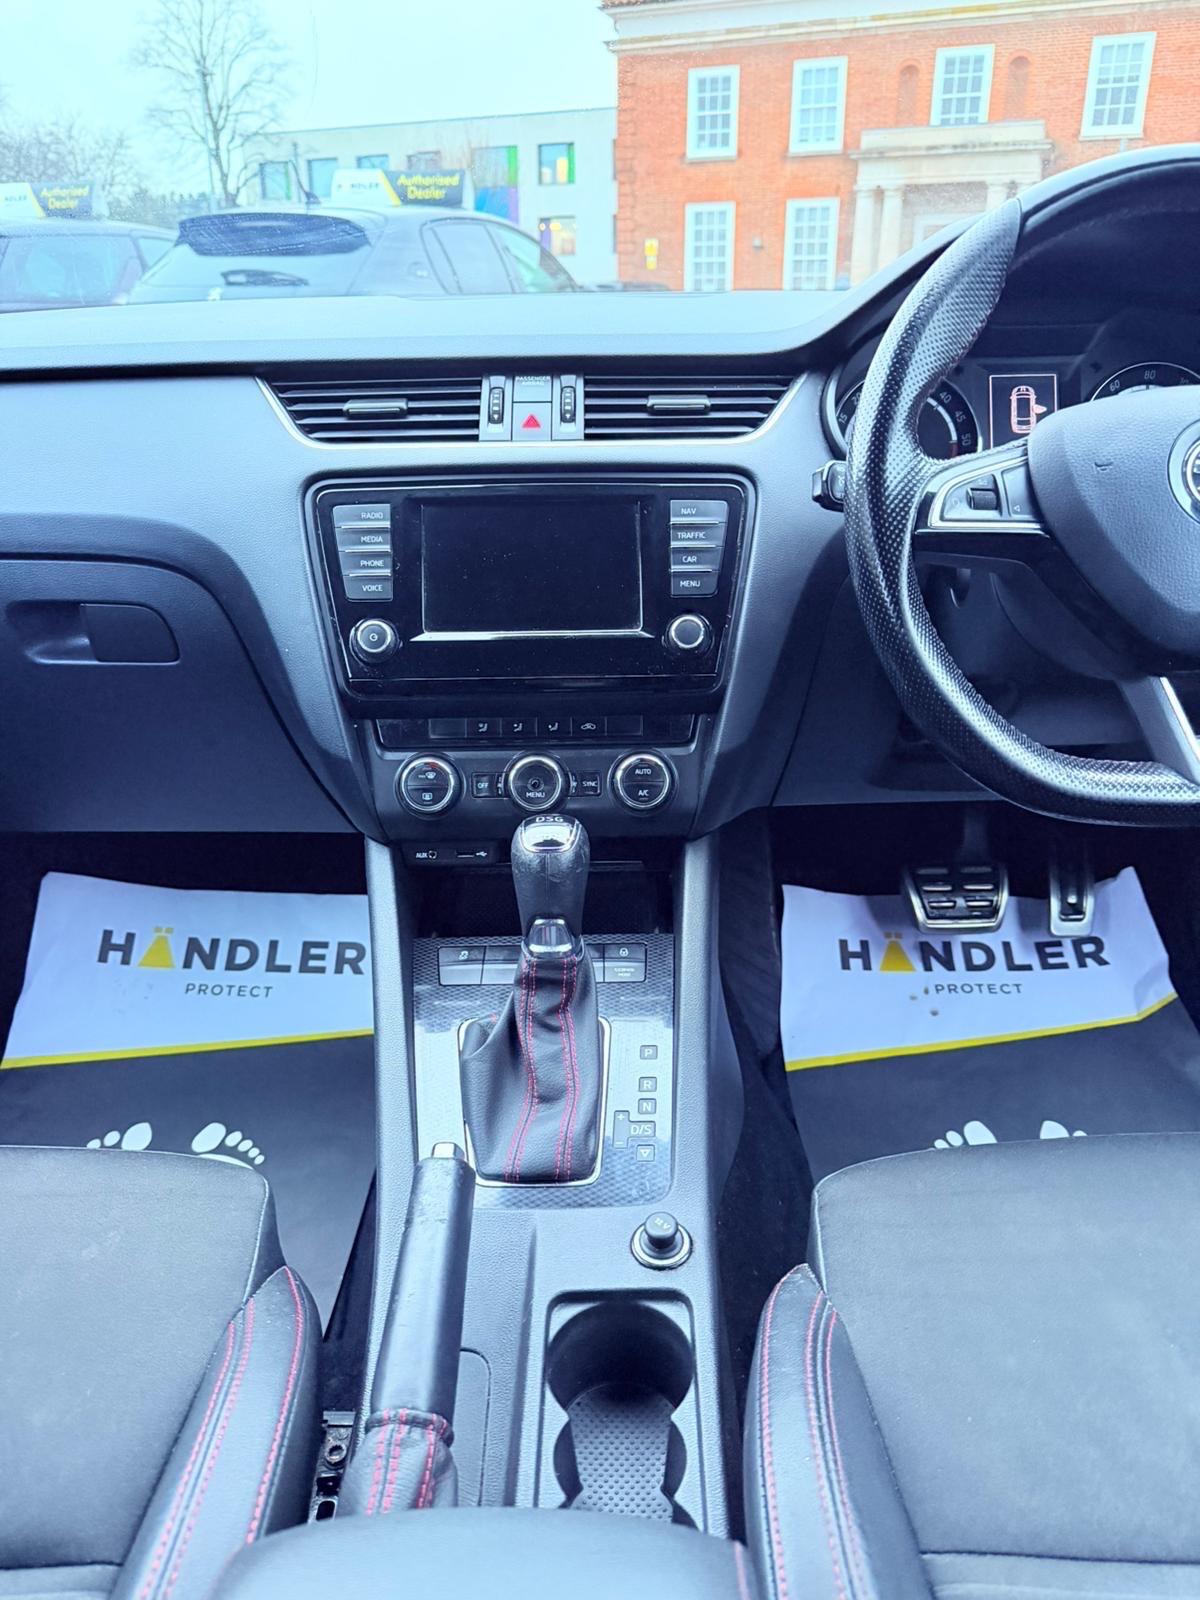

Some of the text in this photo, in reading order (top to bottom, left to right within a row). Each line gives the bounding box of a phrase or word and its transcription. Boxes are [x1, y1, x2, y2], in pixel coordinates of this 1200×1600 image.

[407, 186, 446, 200] Dealer
[1144, 370, 1156, 380] 80
[1109, 380, 1120, 392] 60
[851, 391, 862, 405] 20
[939, 390, 952, 404] 40
[838, 414, 848, 425] 15
[954, 410, 966, 423] 45
[961, 433, 971, 446] 50
[361, 511, 384, 519] RADIO
[680, 507, 697, 515] NAV
[360, 535, 383, 543] MEDIA
[677, 531, 706, 539] TRAFFIC
[360, 559, 385, 567] PHONE
[682, 555, 697, 563] CAR
[361, 584, 383, 592] VOICE
[679, 579, 701, 588] MENU
[477, 781, 489, 789] OFF
[582, 780, 598, 788] SYNC
[526, 791, 545, 799] MENU
[638, 789, 650, 797] A/C
[415, 851, 428, 859] AUX
[97, 925, 367, 976] HÄNDLER
[838, 931, 1111, 974] HÄNDLER
[185, 982, 274, 998] PROTECT
[935, 982, 1023, 995] PROTECT
[643, 1048, 653, 1057] P
[642, 1080, 652, 1089] R
[642, 1101, 652, 1111] N
[630, 1124, 652, 1134] D/S
